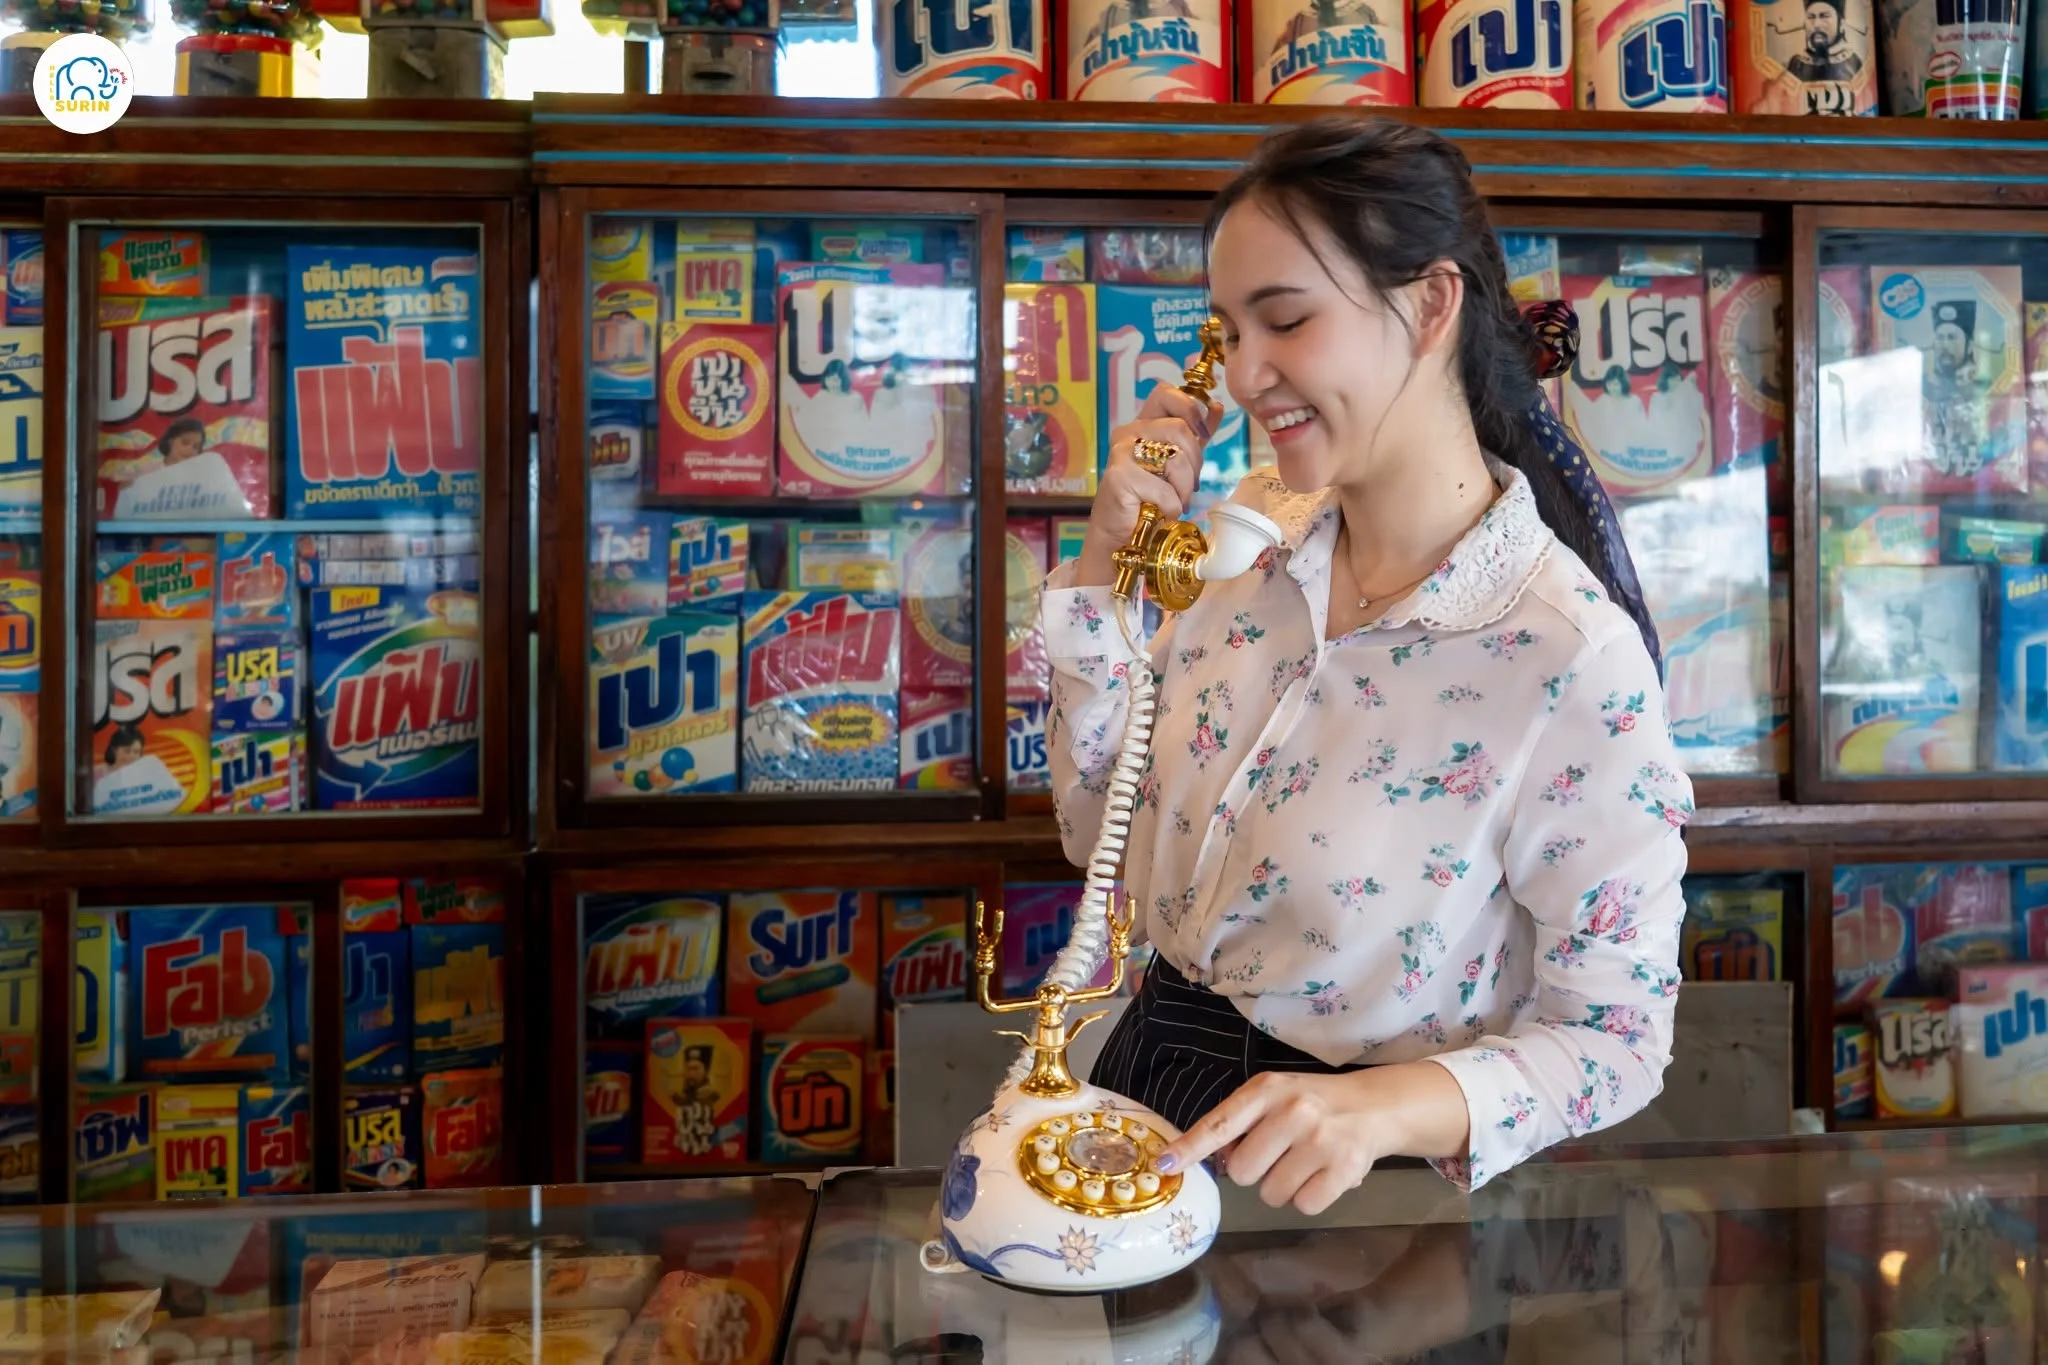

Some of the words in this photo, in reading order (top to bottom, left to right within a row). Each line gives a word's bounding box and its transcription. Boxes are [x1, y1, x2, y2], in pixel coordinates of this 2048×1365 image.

[1154, 329, 1193, 345] Wise
[222, 551, 287, 606] Fab
[598, 631, 722, 752] เปา
[749, 888, 860, 980] Surf
[143, 926, 274, 1038] Fab
[183, 1012, 273, 1046] Perfect
